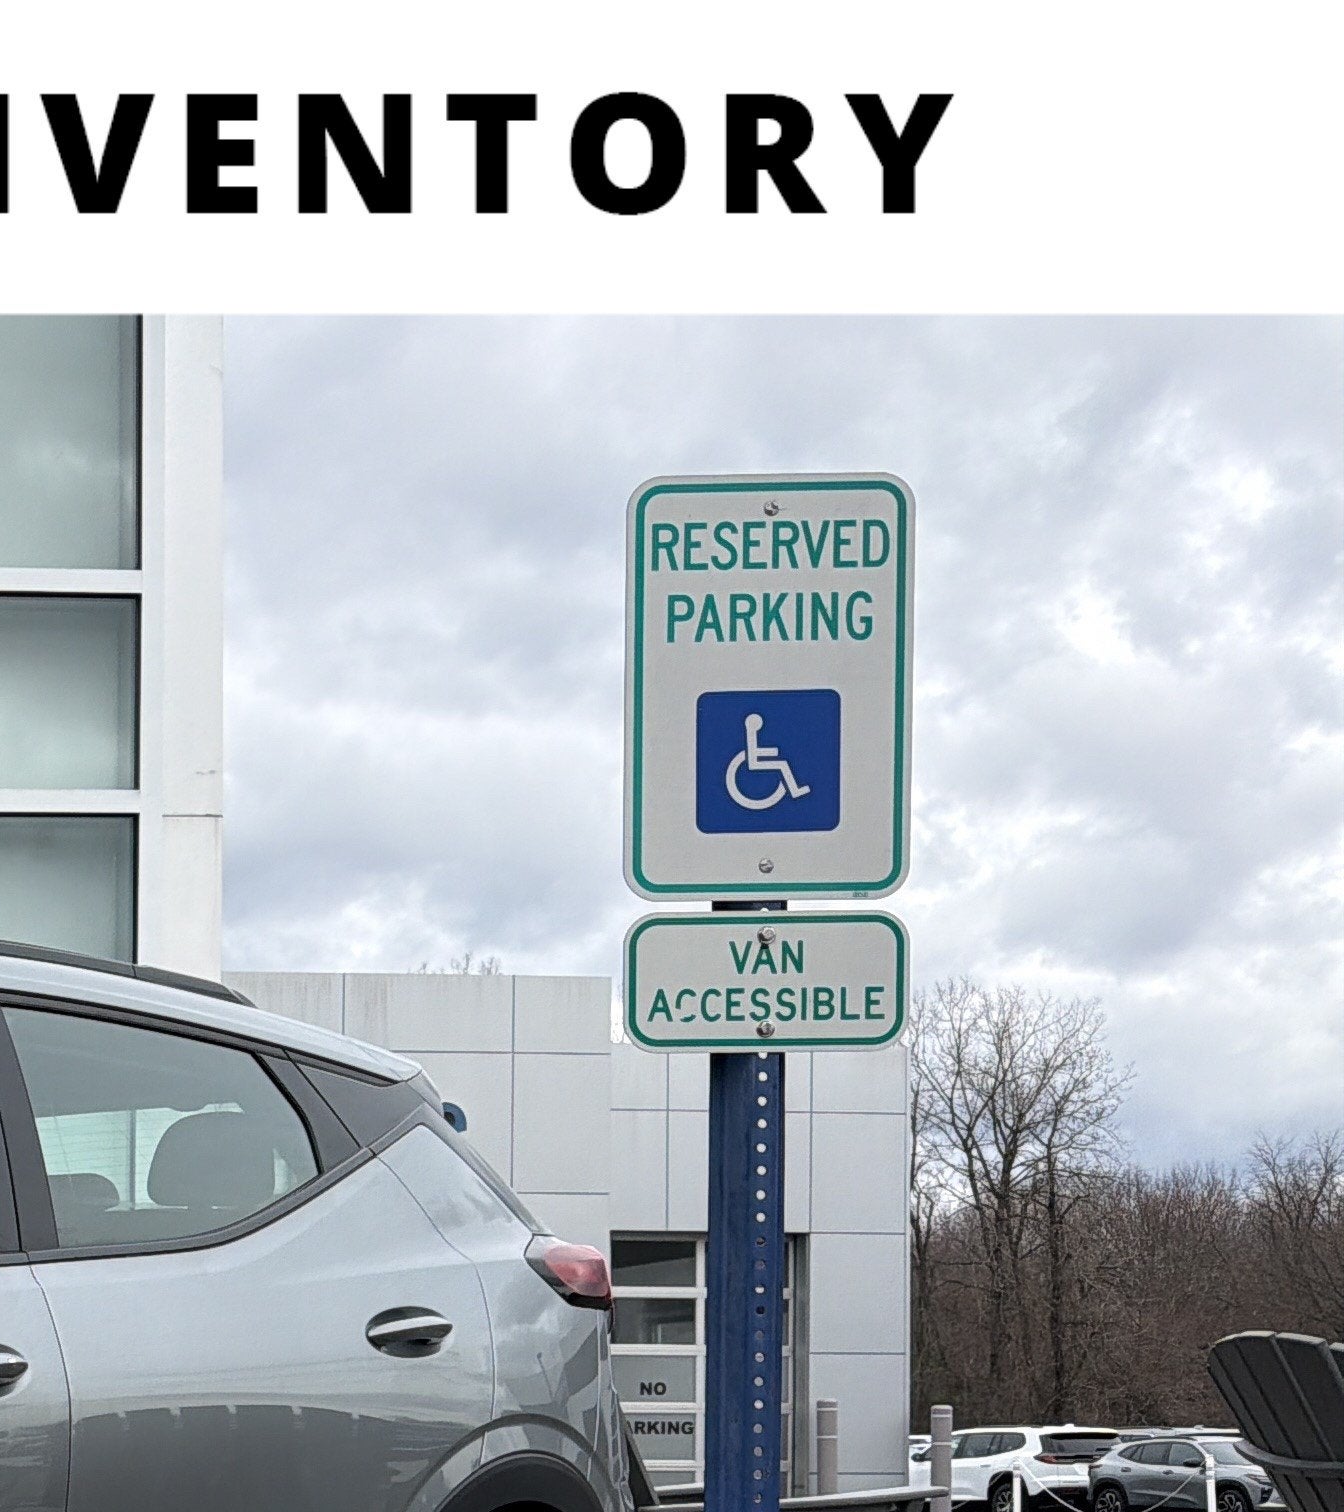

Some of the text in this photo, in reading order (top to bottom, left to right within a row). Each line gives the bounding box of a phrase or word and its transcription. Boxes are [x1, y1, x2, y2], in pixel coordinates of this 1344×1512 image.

[651, 519, 891, 572] RESERVED
[666, 590, 874, 643] PARKING
[729, 940, 804, 975] VAN
[648, 987, 885, 1023] ACCESSIBLE
[639, 1381, 667, 1396] NO
[626, 1420, 695, 1435] RKING
